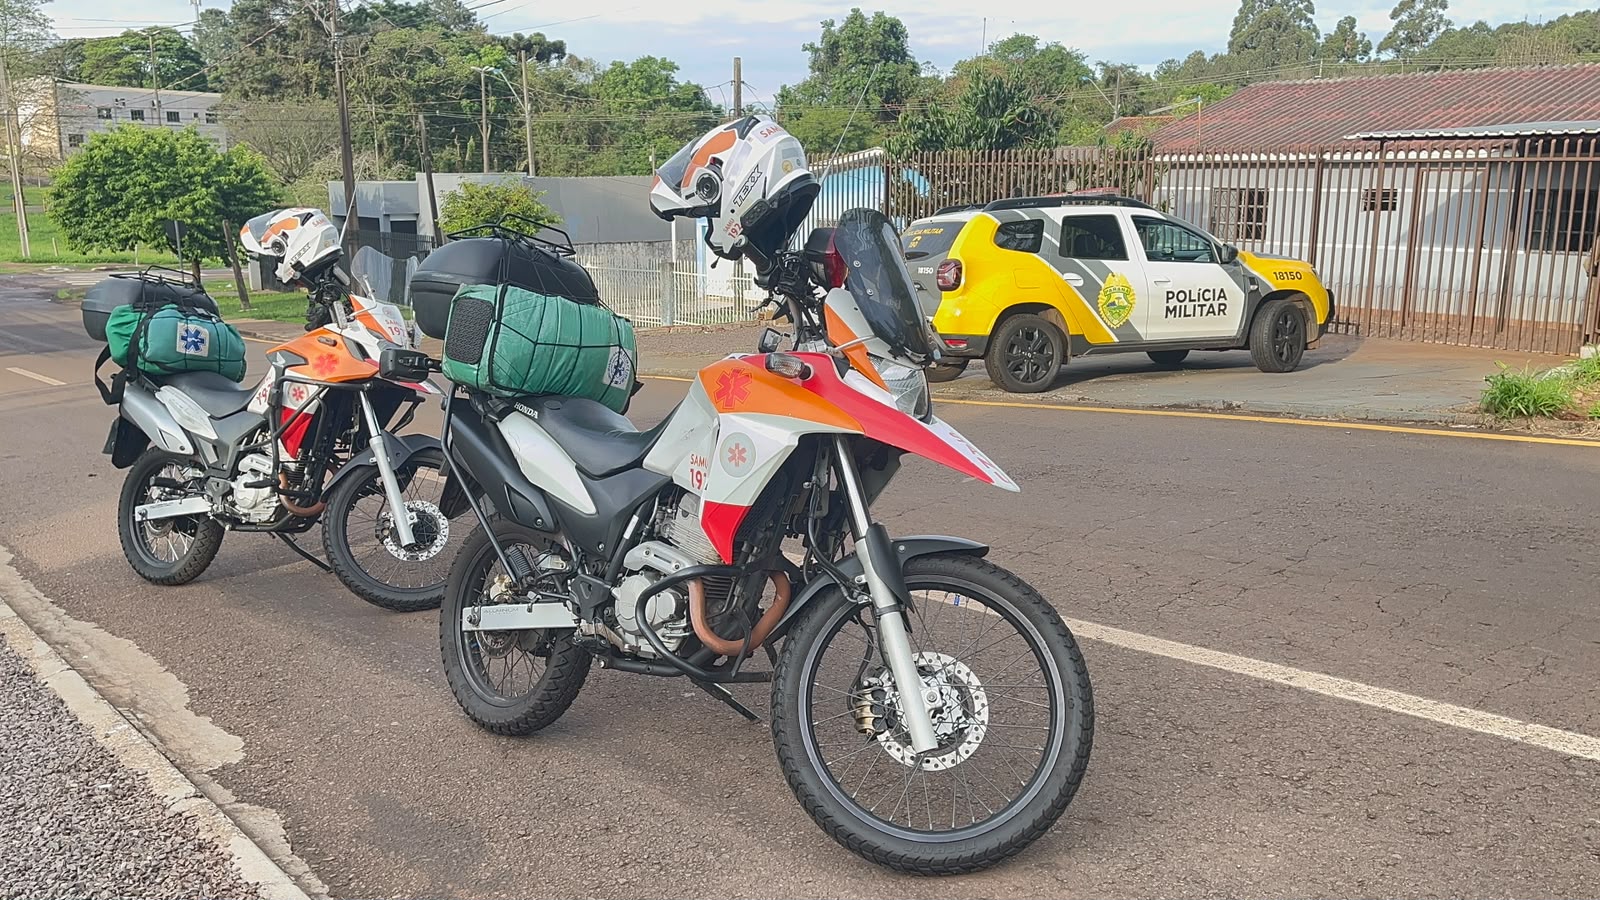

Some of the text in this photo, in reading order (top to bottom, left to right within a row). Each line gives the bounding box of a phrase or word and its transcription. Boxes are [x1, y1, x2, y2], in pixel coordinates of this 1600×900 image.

[733, 163, 763, 207] TEXX
[728, 223, 744, 239] 192
[1273, 271, 1303, 281] 18150
[1165, 288, 1227, 304] POLÍCIA
[1164, 303, 1227, 319] MILITAR
[514, 402, 539, 419] HONDA
